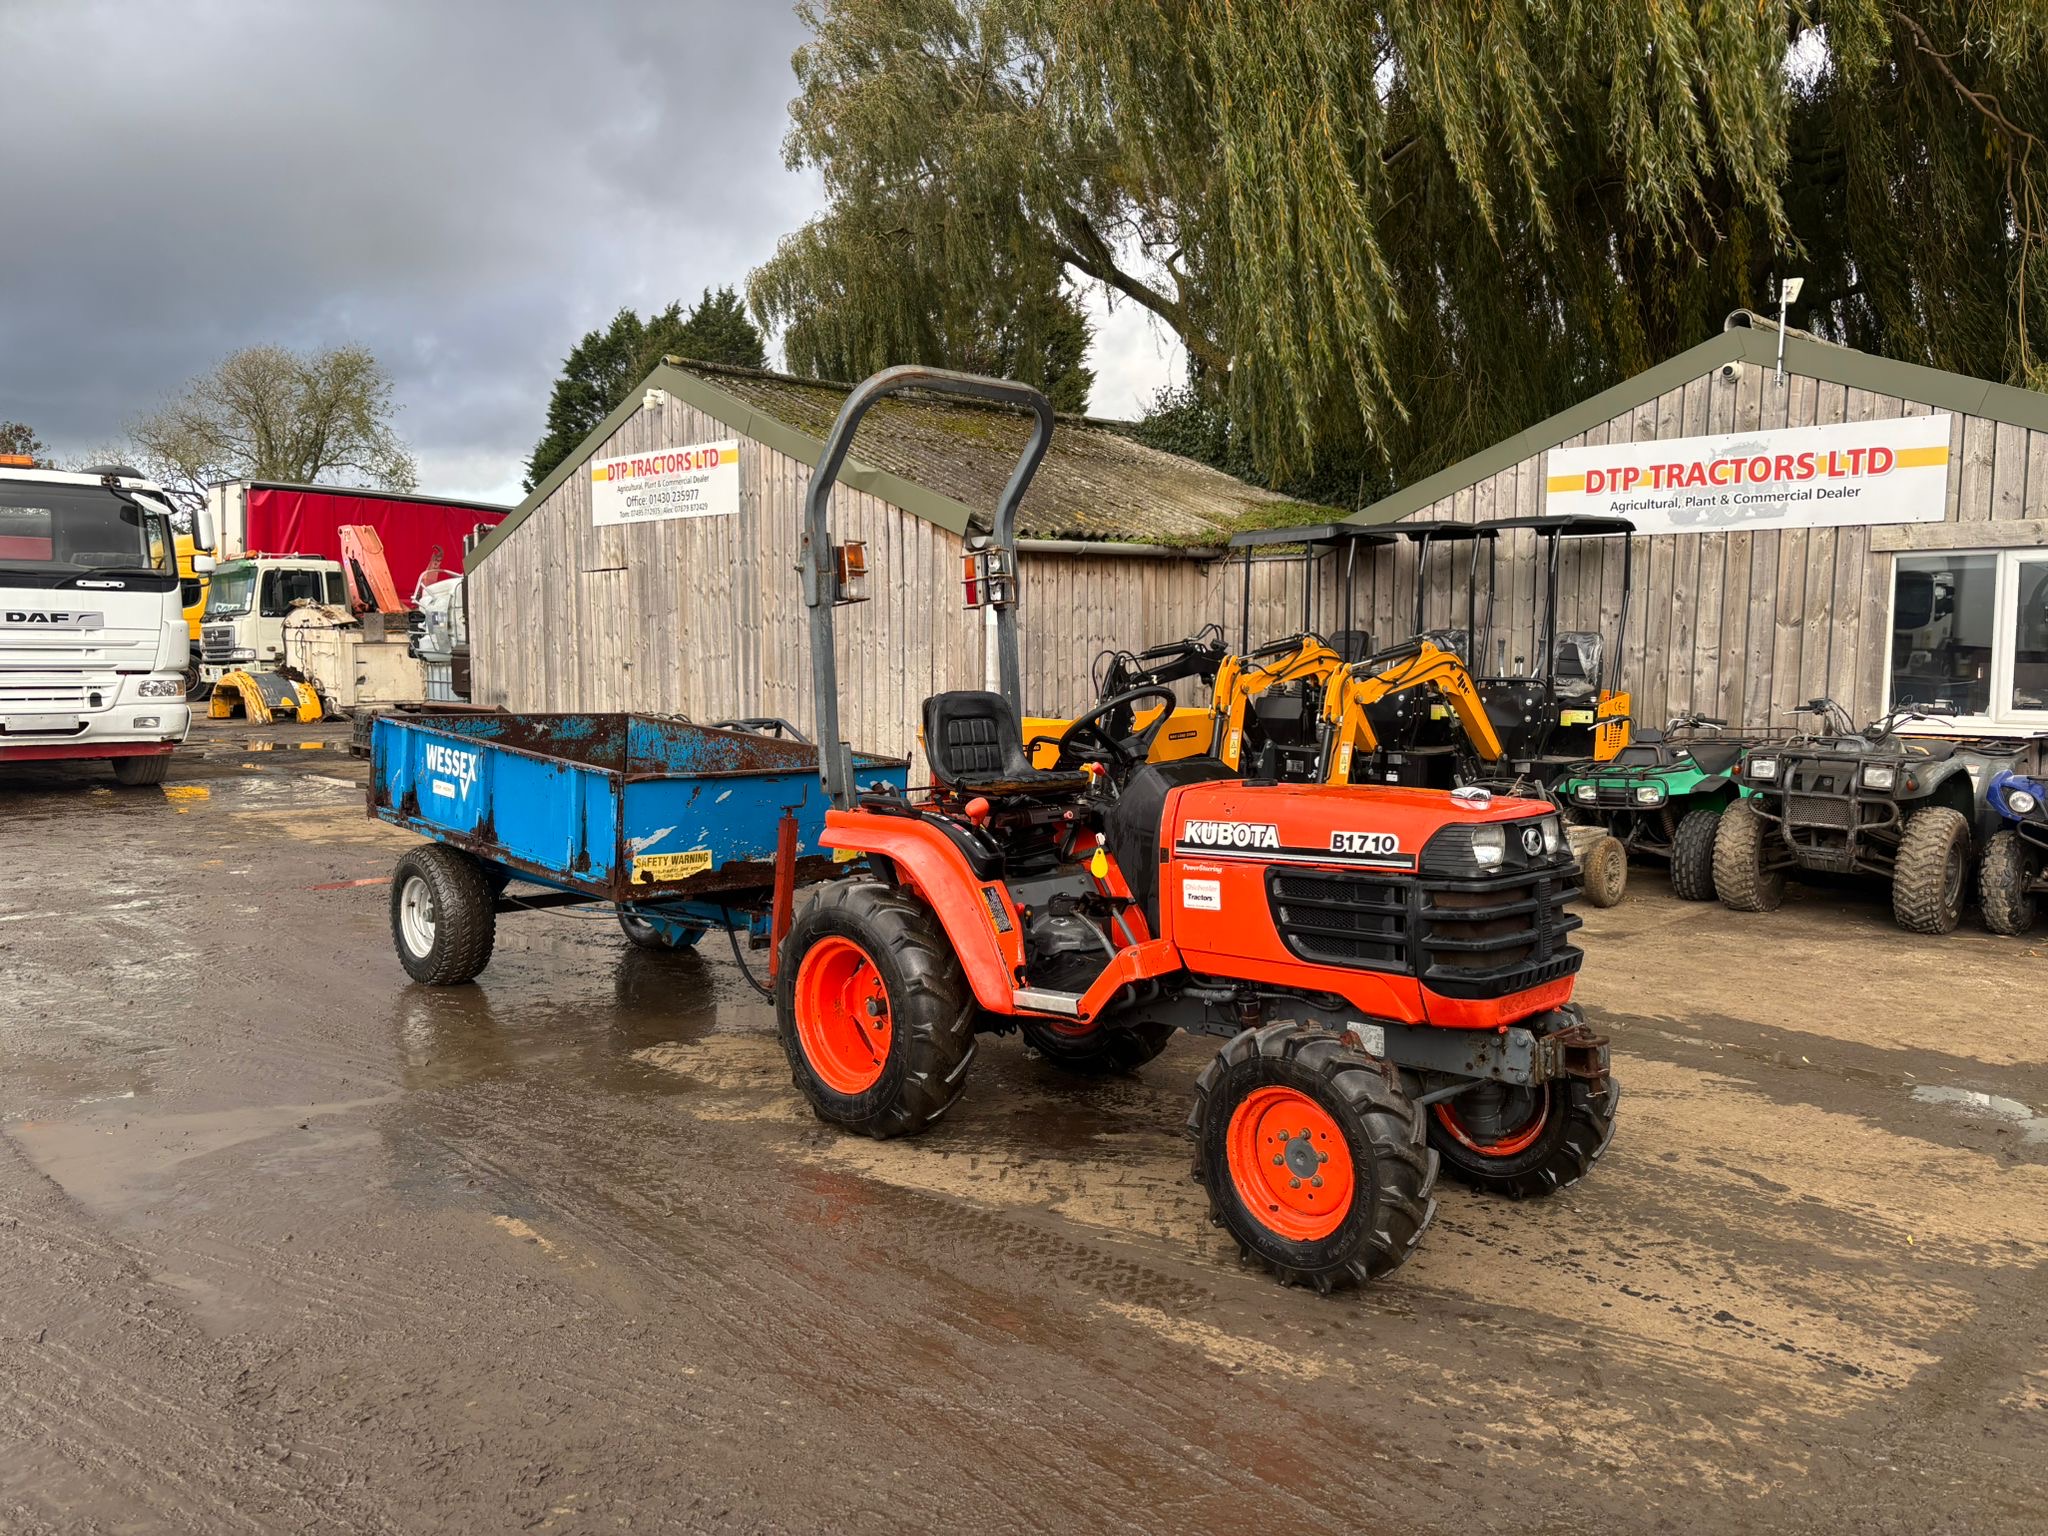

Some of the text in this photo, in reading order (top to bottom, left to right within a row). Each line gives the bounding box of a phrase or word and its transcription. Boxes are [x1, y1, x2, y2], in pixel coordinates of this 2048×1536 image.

[608, 448, 719, 481] DTP TRACTORS LTD
[1586, 447, 1894, 494] DTP TRACTORS LTD
[645, 481, 657, 489] Plant
[657, 480, 662, 488] &
[662, 477, 692, 488] Commercial
[693, 475, 710, 484] Dealer
[626, 489, 699, 507] Office: 01430 235977
[1610, 486, 1861, 513] Agricultural, Plant & Commercial Dealer
[5, 612, 69, 623] DAF
[426, 743, 477, 783] WESSEX
[1183, 820, 1280, 848] KUBOTA
[1332, 833, 1396, 852] B1710
[636, 852, 709, 868] SAFETY WARNING
[1188, 893, 1213, 901] Tractors
